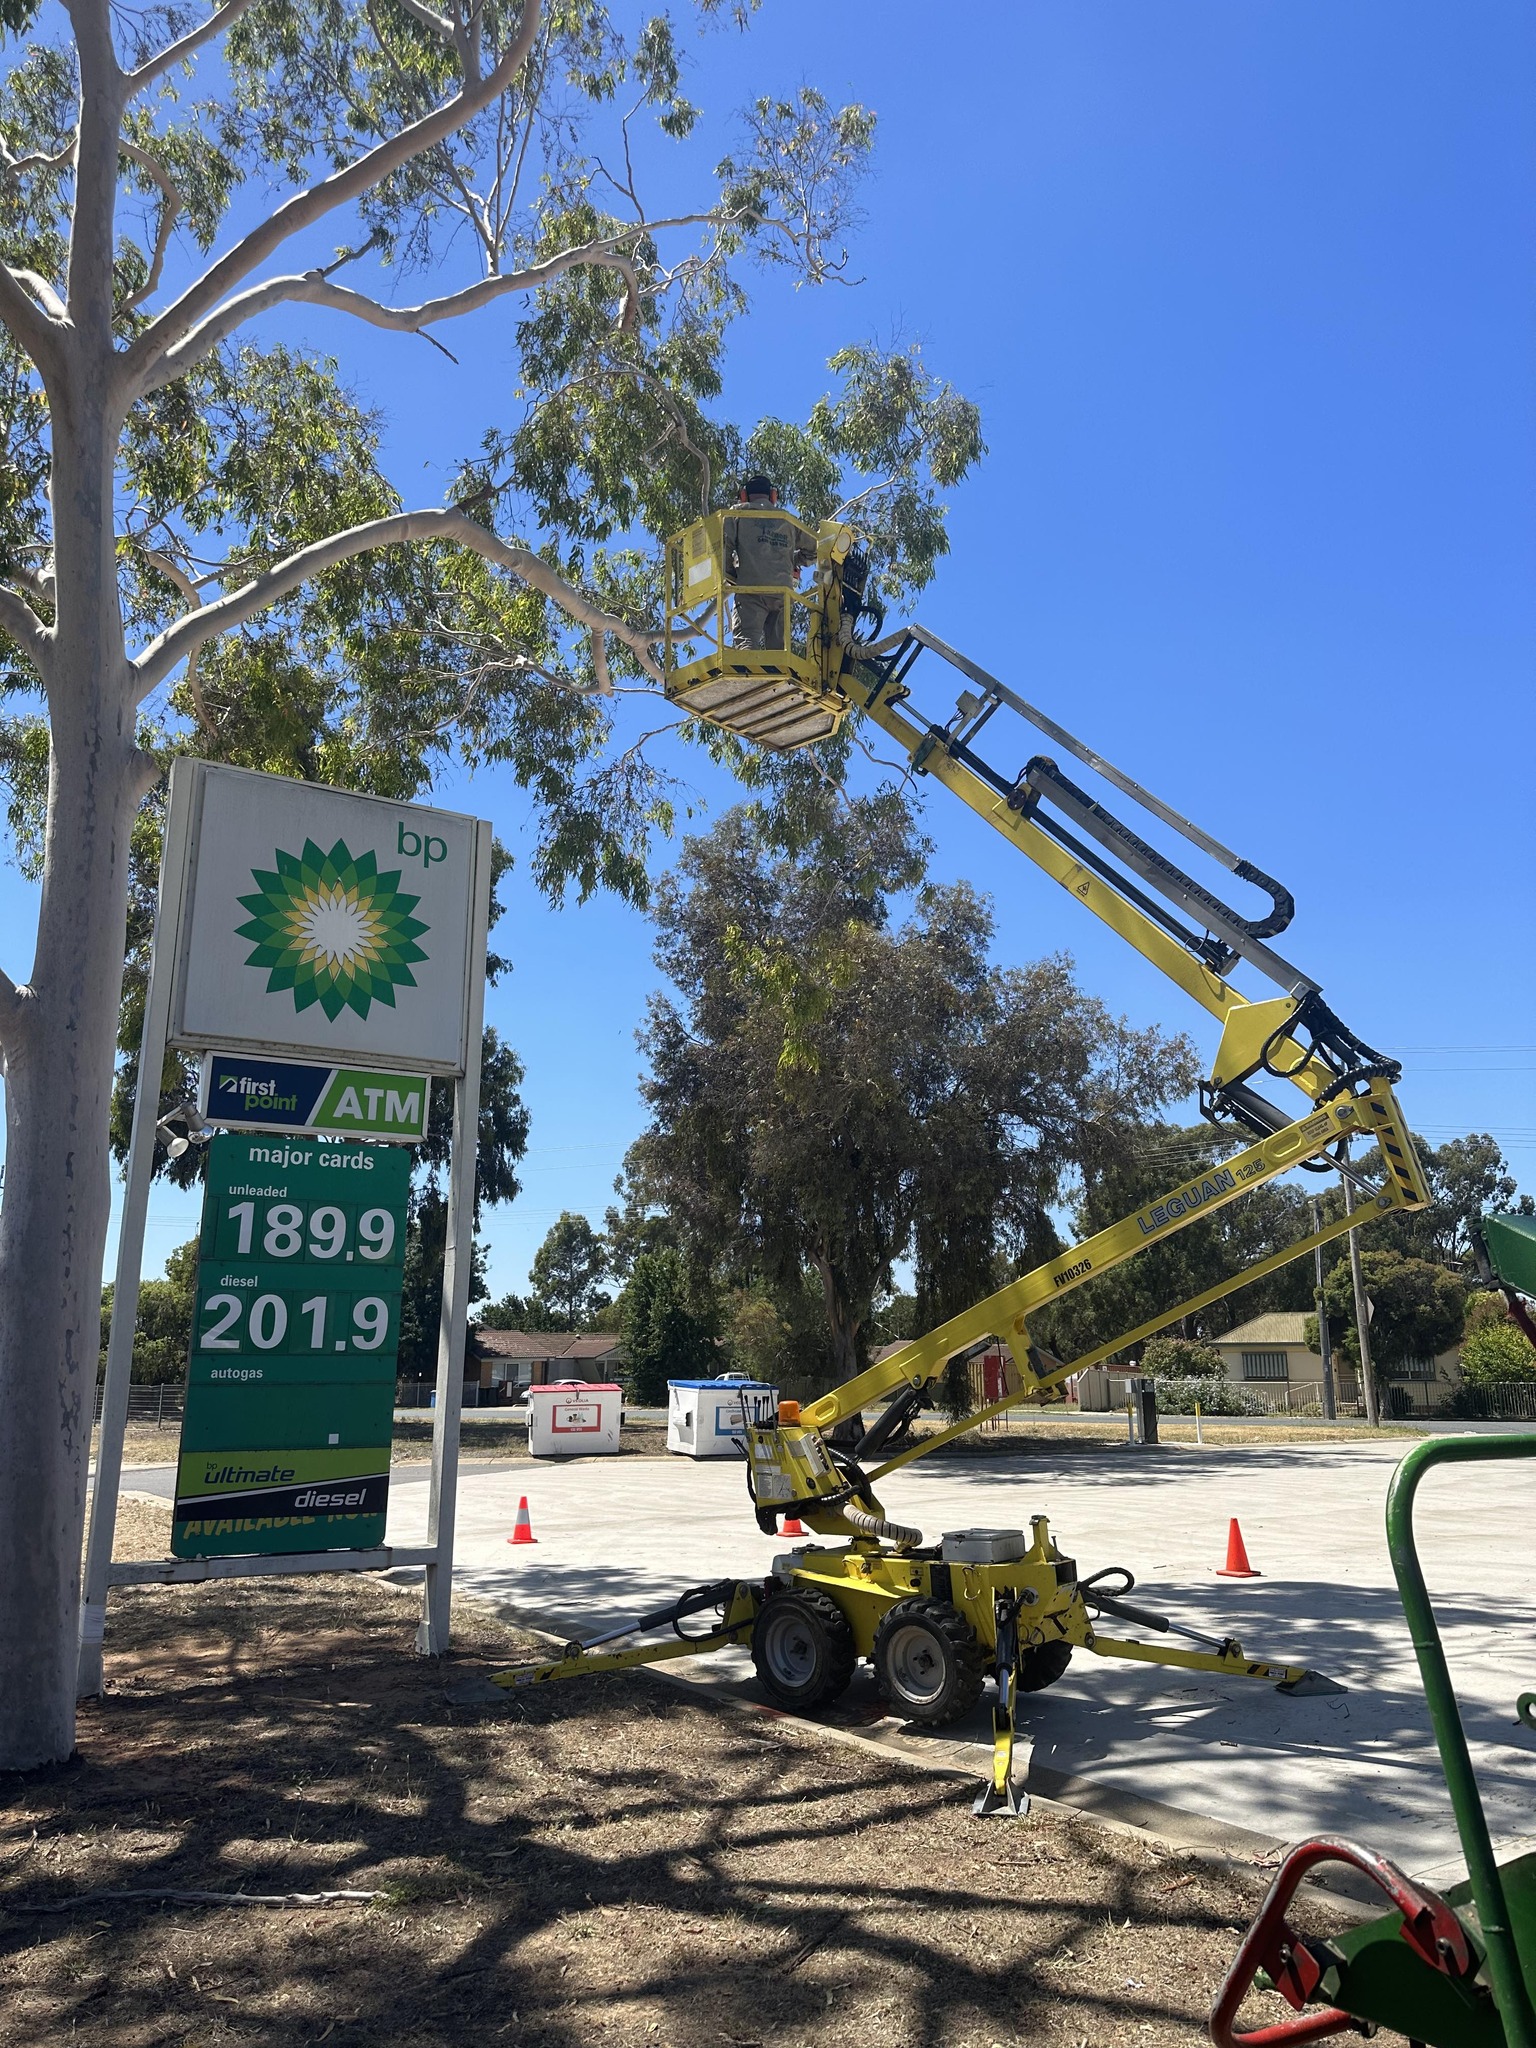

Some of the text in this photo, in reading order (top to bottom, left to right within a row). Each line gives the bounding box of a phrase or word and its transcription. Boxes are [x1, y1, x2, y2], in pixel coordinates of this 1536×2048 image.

[397, 821, 448, 868] bp
[239, 1077, 276, 1096] first
[244, 1093, 298, 1111] point
[332, 1086, 420, 1124] ATM
[249, 1146, 374, 1170] major cards
[228, 1183, 288, 1198] unleaded
[1137, 1158, 1266, 1235] LEGUAN 125
[228, 1201, 395, 1261] 189.9
[220, 1274, 258, 1288] diesel
[1053, 1258, 1092, 1288] FV10326
[200, 1293, 389, 1351] 201.9
[210, 1367, 264, 1381] autogas
[204, 1465, 296, 1484] ultimate
[206, 1461, 217, 1471] bp
[294, 1488, 367, 1508] diesel
